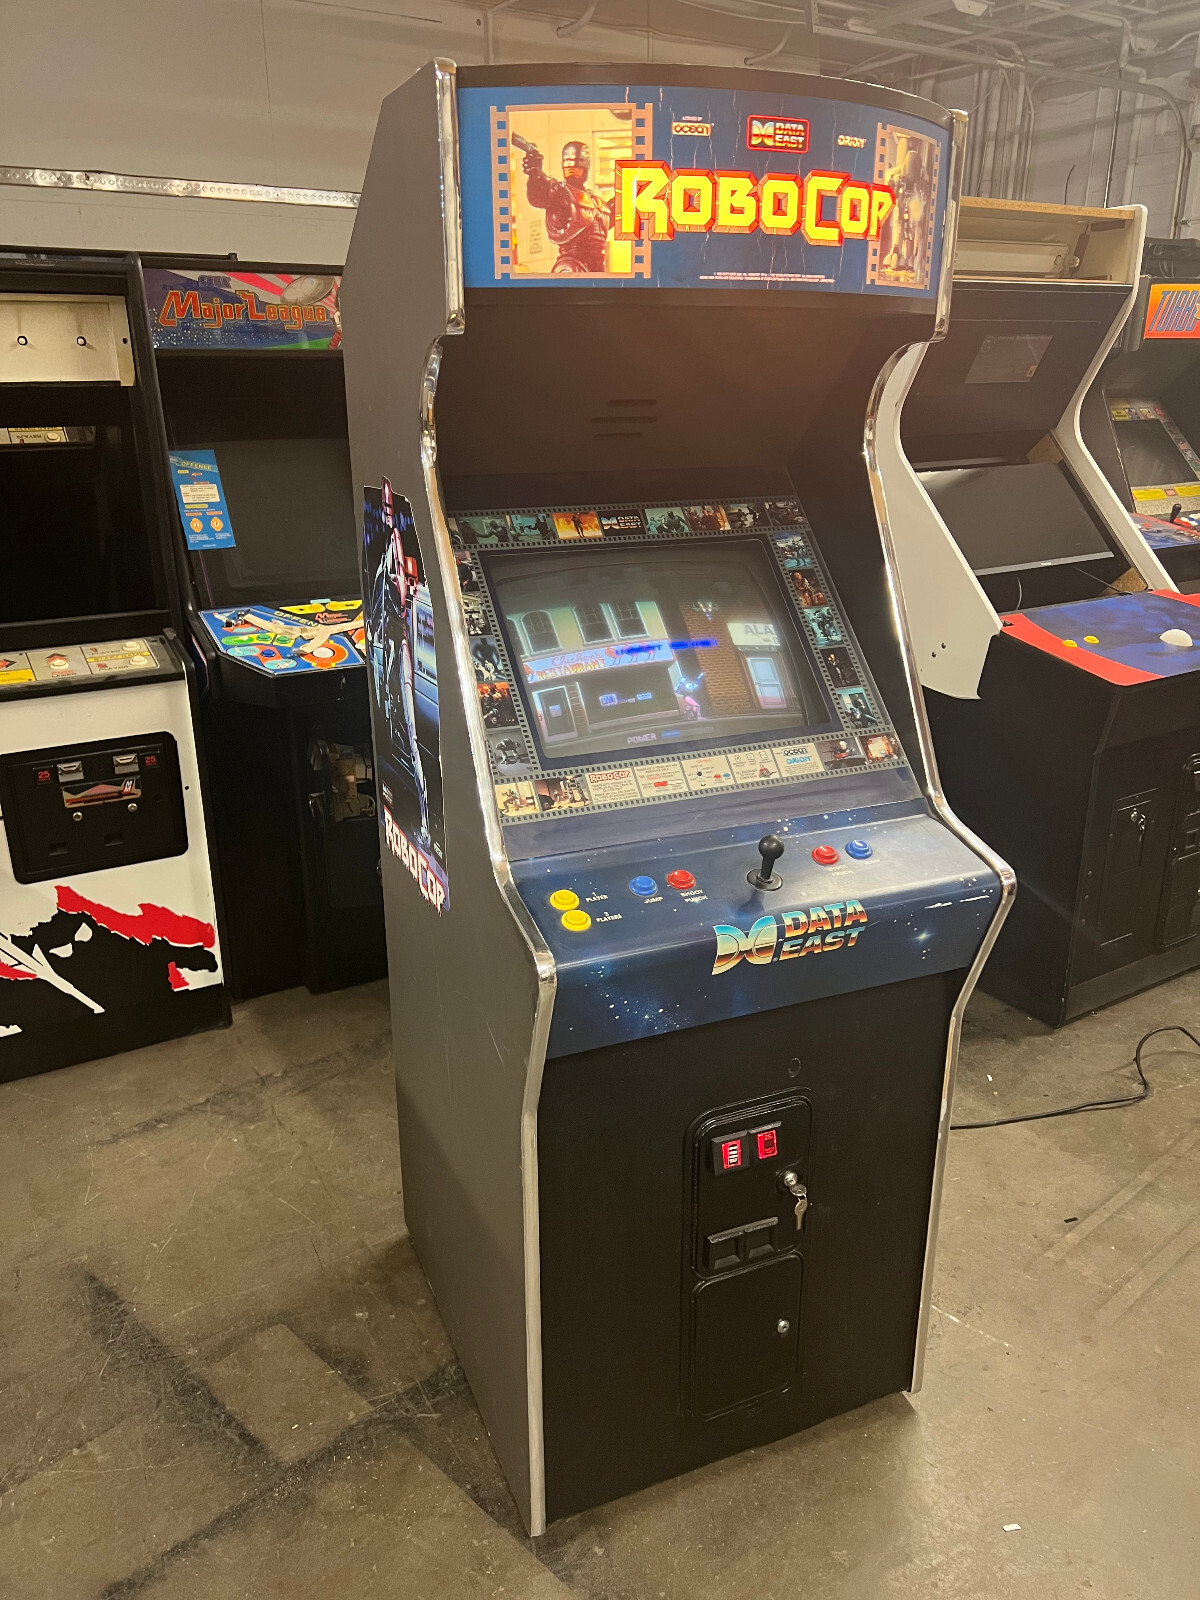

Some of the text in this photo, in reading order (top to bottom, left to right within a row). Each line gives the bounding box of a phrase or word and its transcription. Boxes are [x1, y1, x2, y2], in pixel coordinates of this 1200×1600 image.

[775, 122, 805, 136] DATA
[774, 136, 805, 149] EAST
[158, 290, 328, 330] Major League
[536, 659, 606, 681] RESTAURANT
[626, 733, 657, 745] POWER
[144, 755, 157, 764] 25
[37, 770, 51, 779] 25
[585, 894, 609, 903] PLAYER
[680, 889, 704, 898] SHOOT
[643, 896, 664, 905] JUMP
[684, 895, 709, 904] PUNCH
[595, 913, 623, 924] PLAYERS
[783, 899, 869, 938] DATA
[779, 926, 868, 962] EAST
